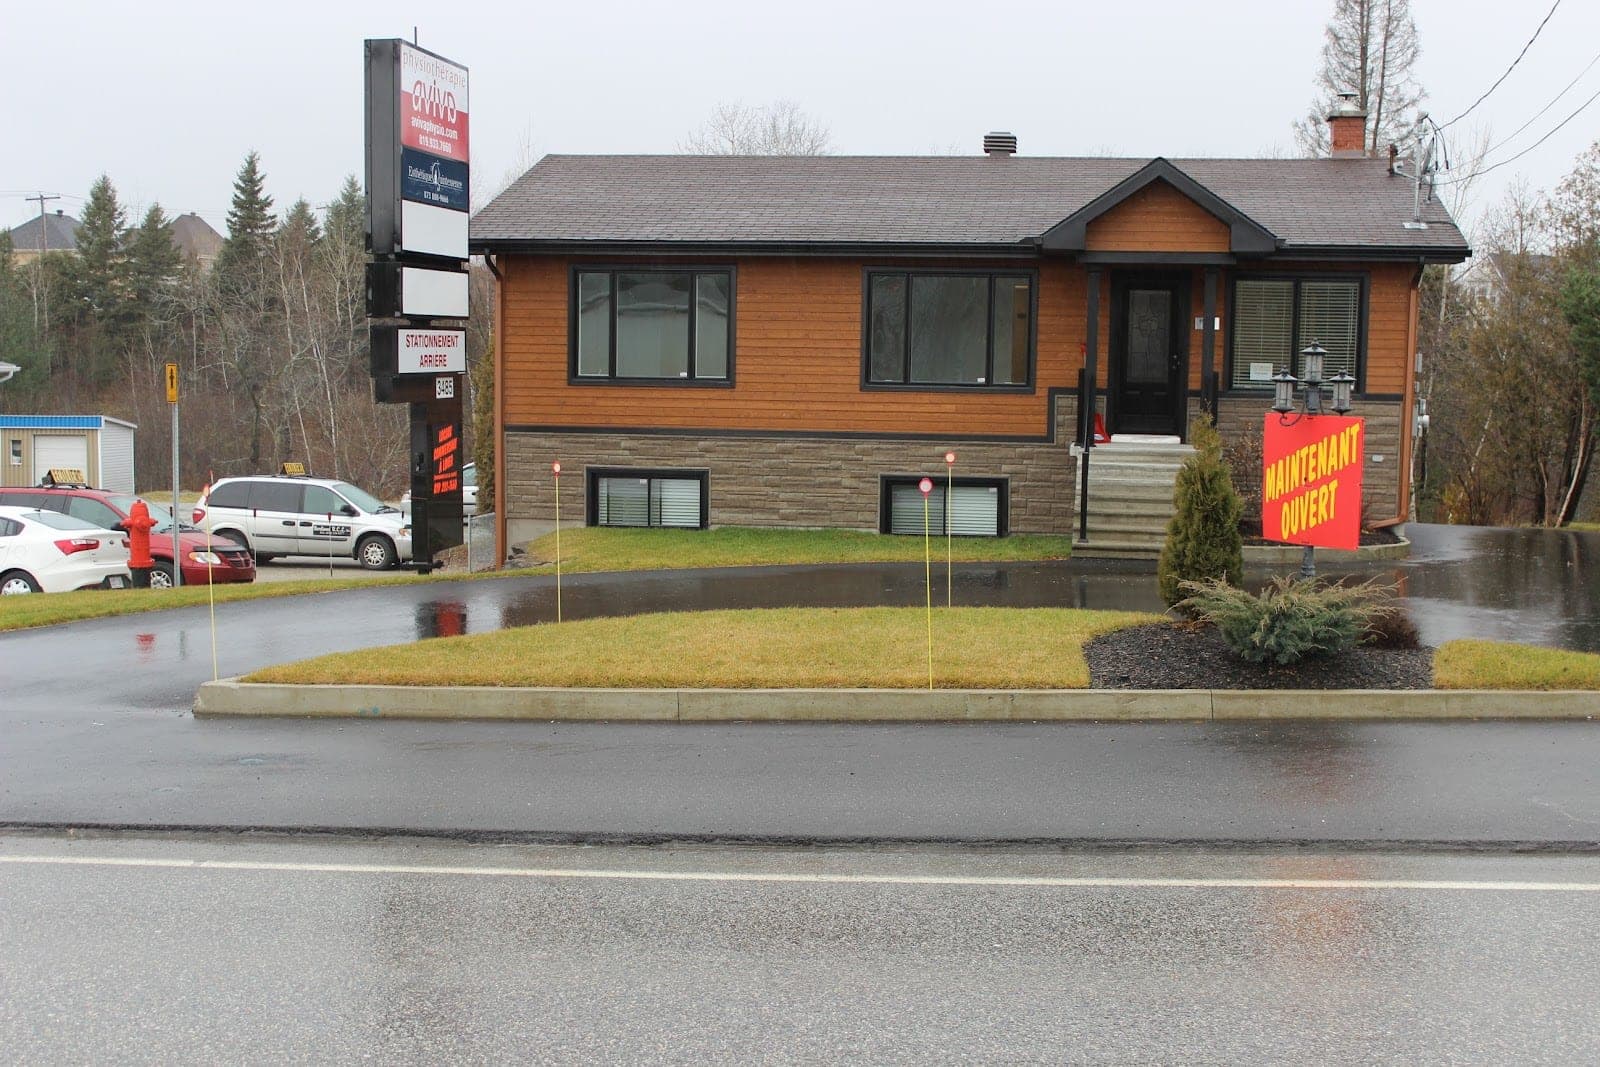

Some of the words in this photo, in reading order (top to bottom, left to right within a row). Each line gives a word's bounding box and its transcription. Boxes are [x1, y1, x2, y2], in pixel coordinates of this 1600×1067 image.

[406, 334, 459, 348] STATIONNEMENT
[437, 380, 453, 396] 3485
[1265, 422, 1360, 503] MAINTENANT
[1281, 479, 1338, 540] OUVERT
